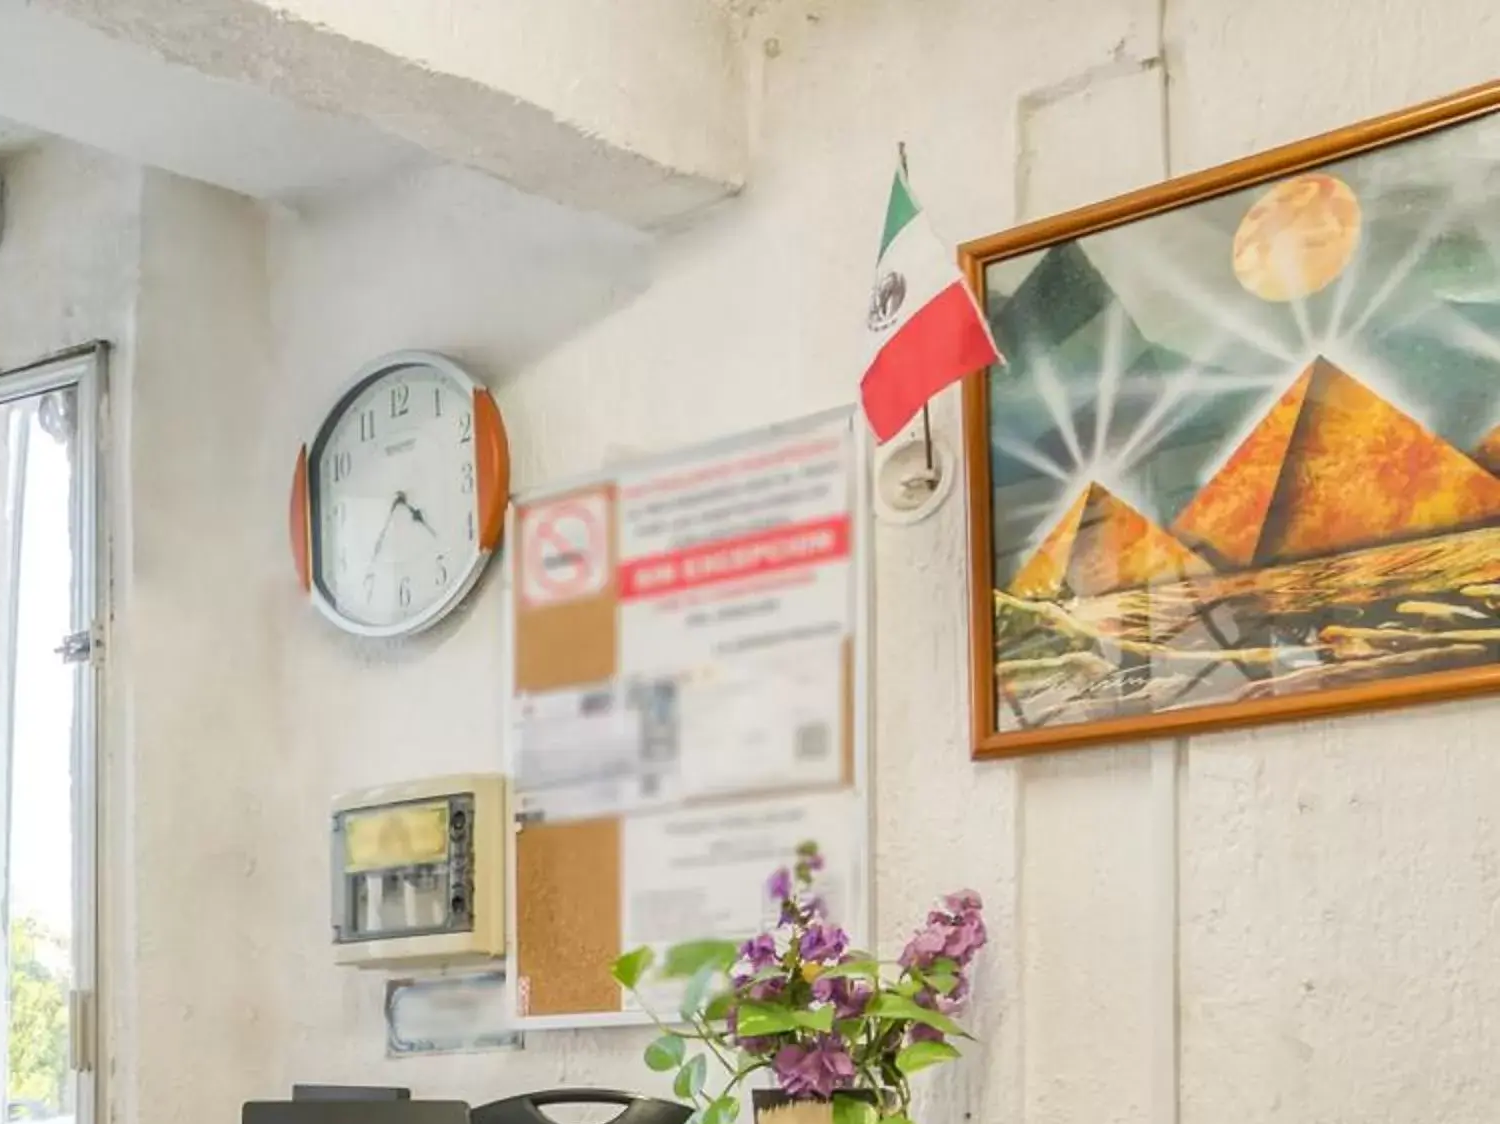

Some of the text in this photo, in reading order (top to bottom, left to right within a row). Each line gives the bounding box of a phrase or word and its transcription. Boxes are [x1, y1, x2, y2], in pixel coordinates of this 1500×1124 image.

[390, 383, 410, 419] 12
[360, 410, 376, 442] 11
[458, 413, 471, 444] 2
[334, 452, 351, 483] 10
